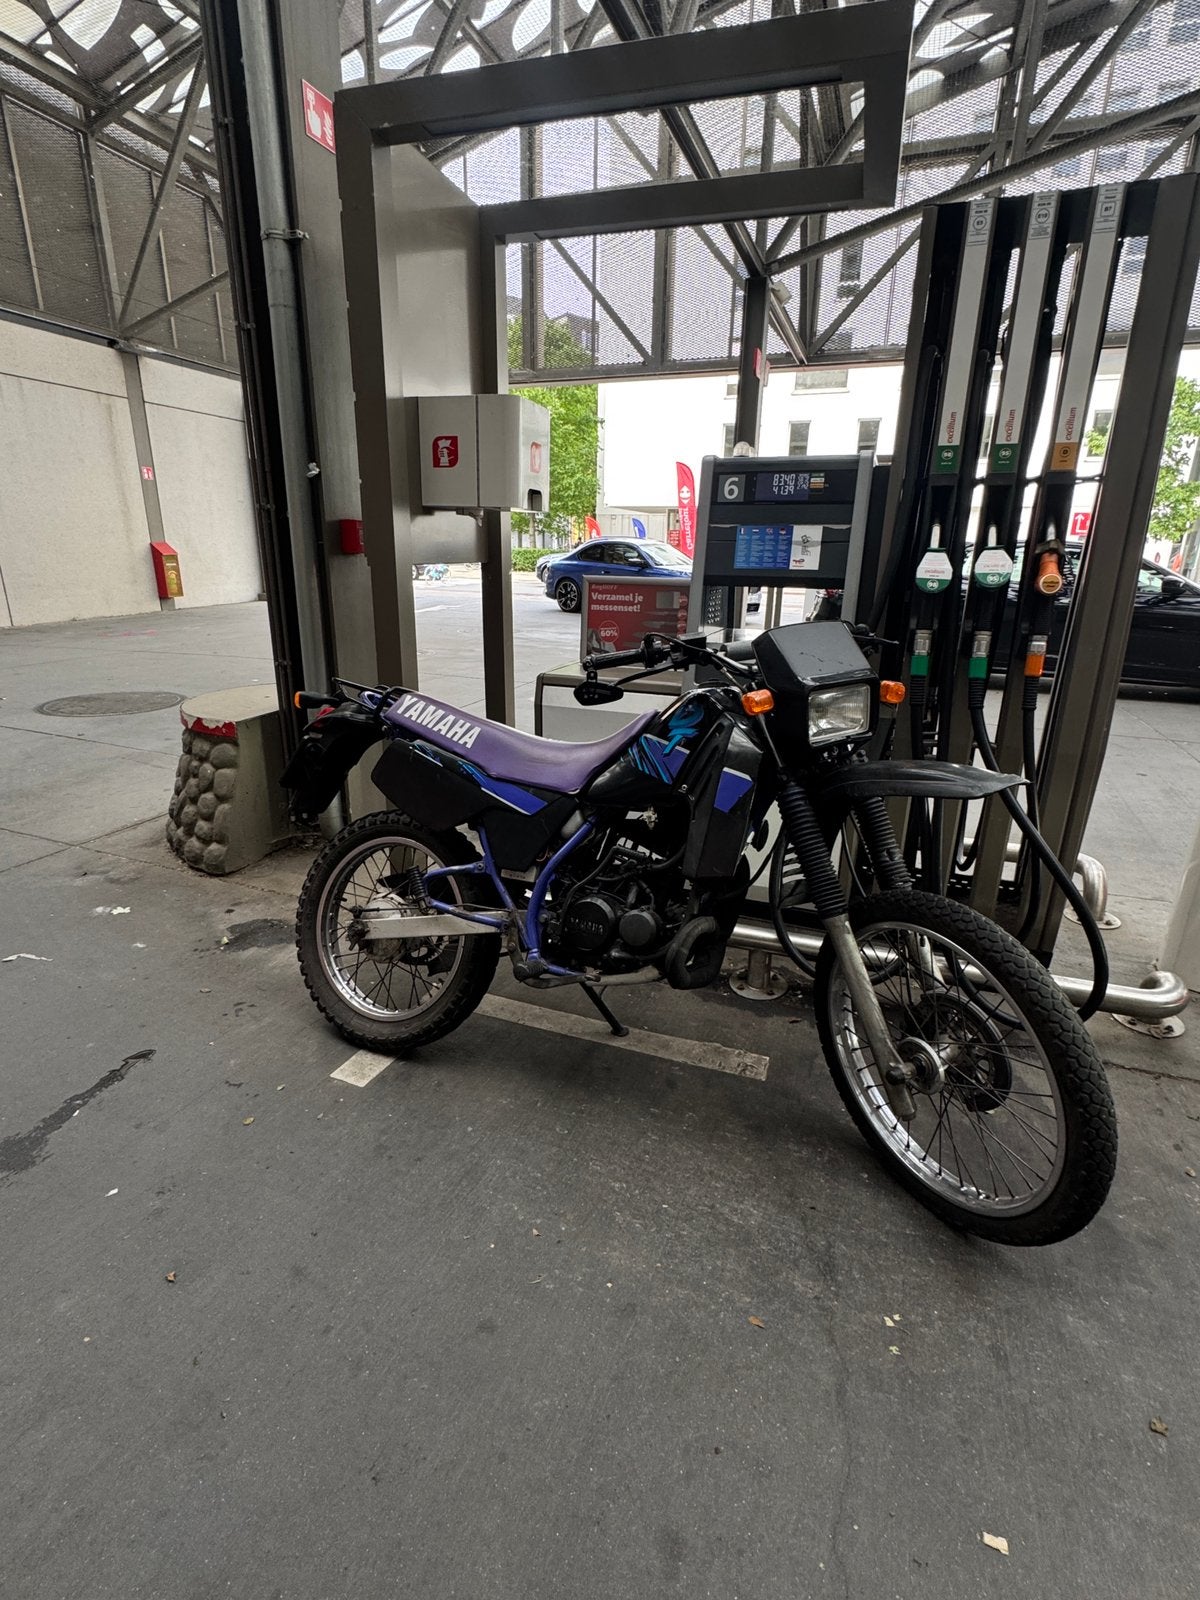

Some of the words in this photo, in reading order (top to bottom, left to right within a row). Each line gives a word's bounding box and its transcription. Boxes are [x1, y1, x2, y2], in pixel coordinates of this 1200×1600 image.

[724, 477, 739, 500] 6
[591, 592, 634, 602] Verzamel
[634, 593, 644, 603] je
[591, 604, 641, 612] messenset!
[600, 629, 618, 637] 60%
[397, 695, 481, 749] YAMAHA
